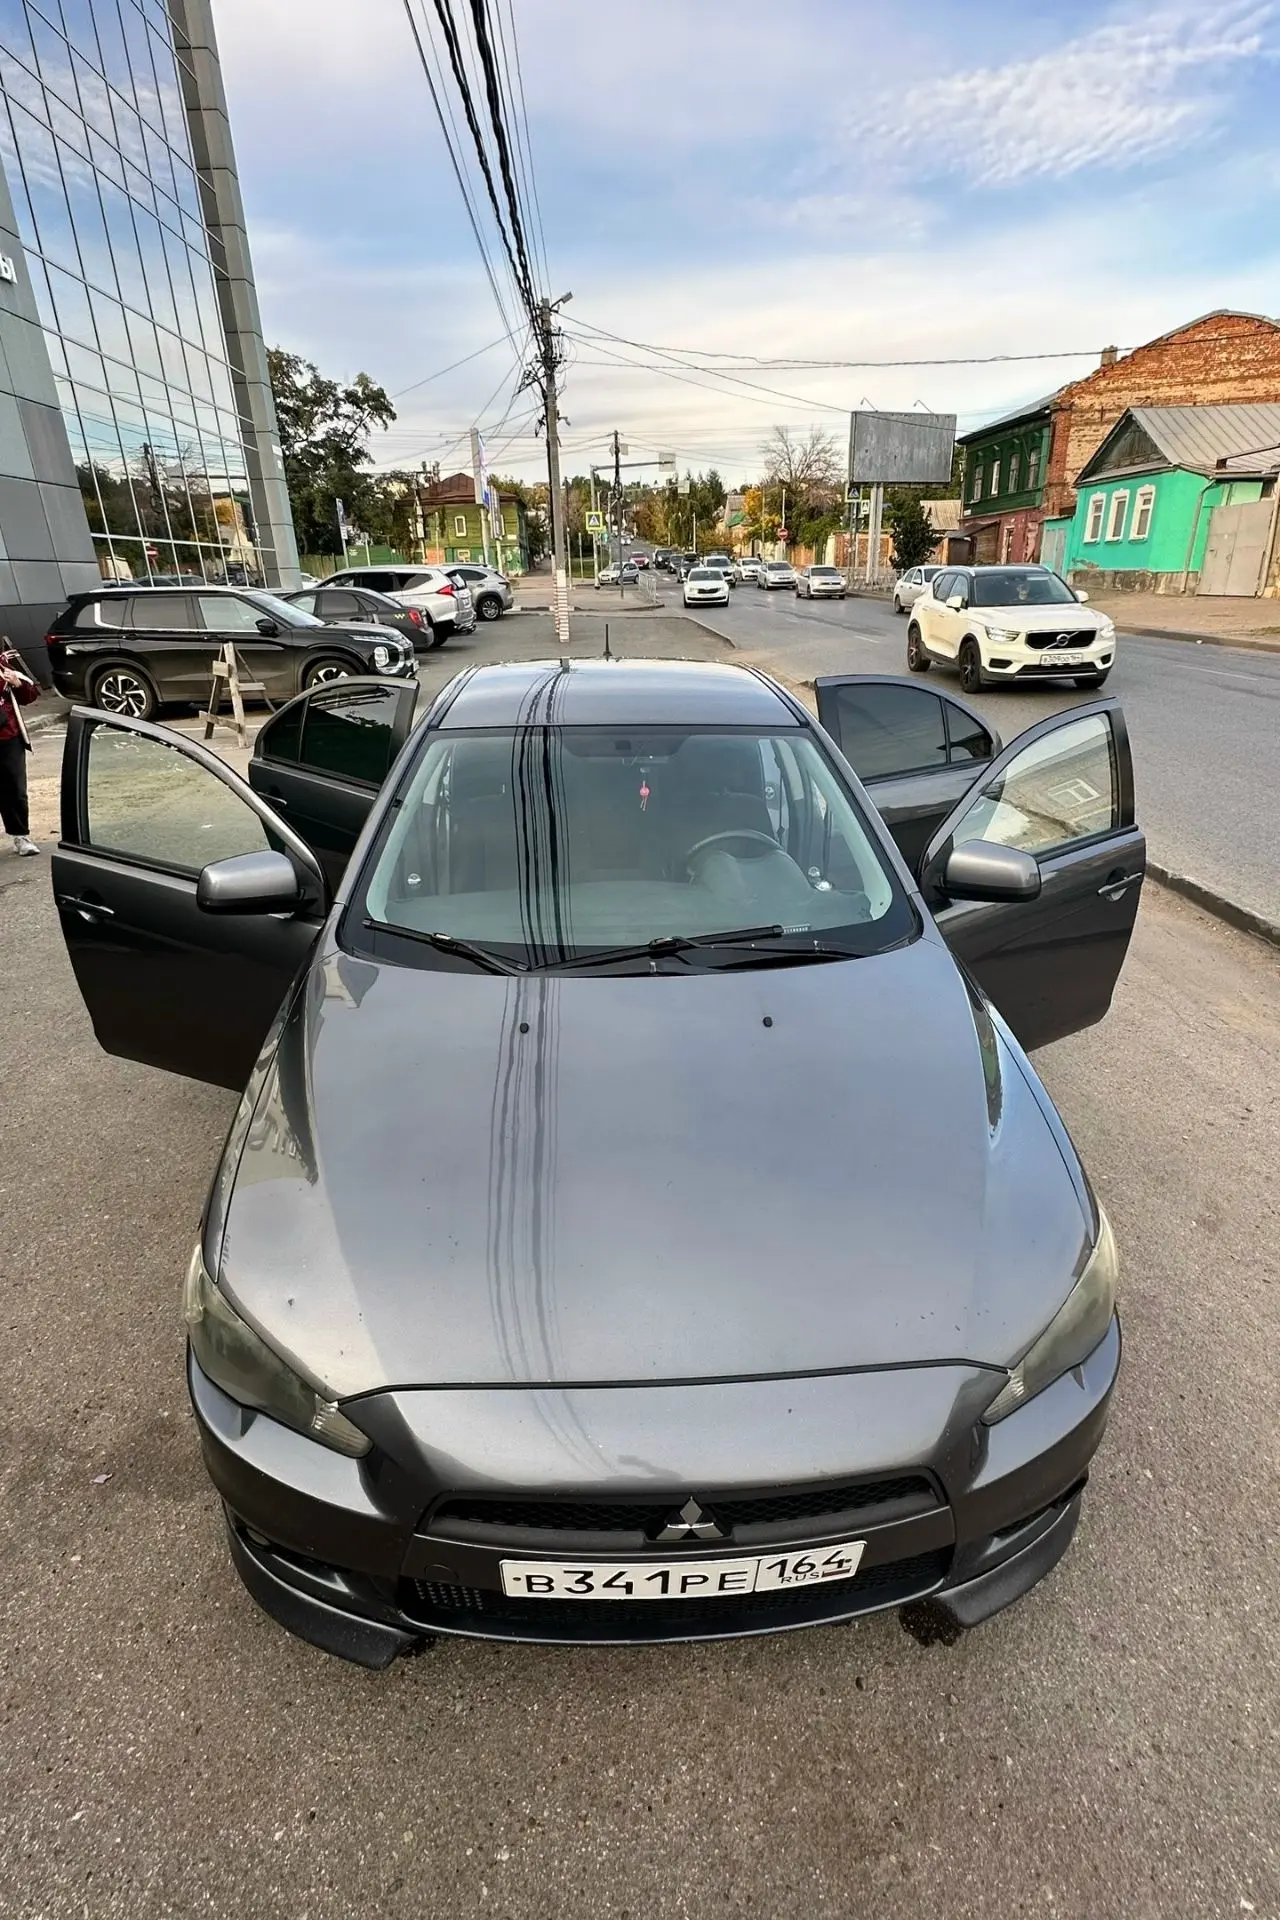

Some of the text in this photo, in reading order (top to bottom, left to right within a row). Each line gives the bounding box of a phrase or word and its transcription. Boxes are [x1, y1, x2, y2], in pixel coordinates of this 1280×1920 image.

[526, 1550, 846, 1595] В341РЕ 164
[780, 1571, 820, 1584] RUS
